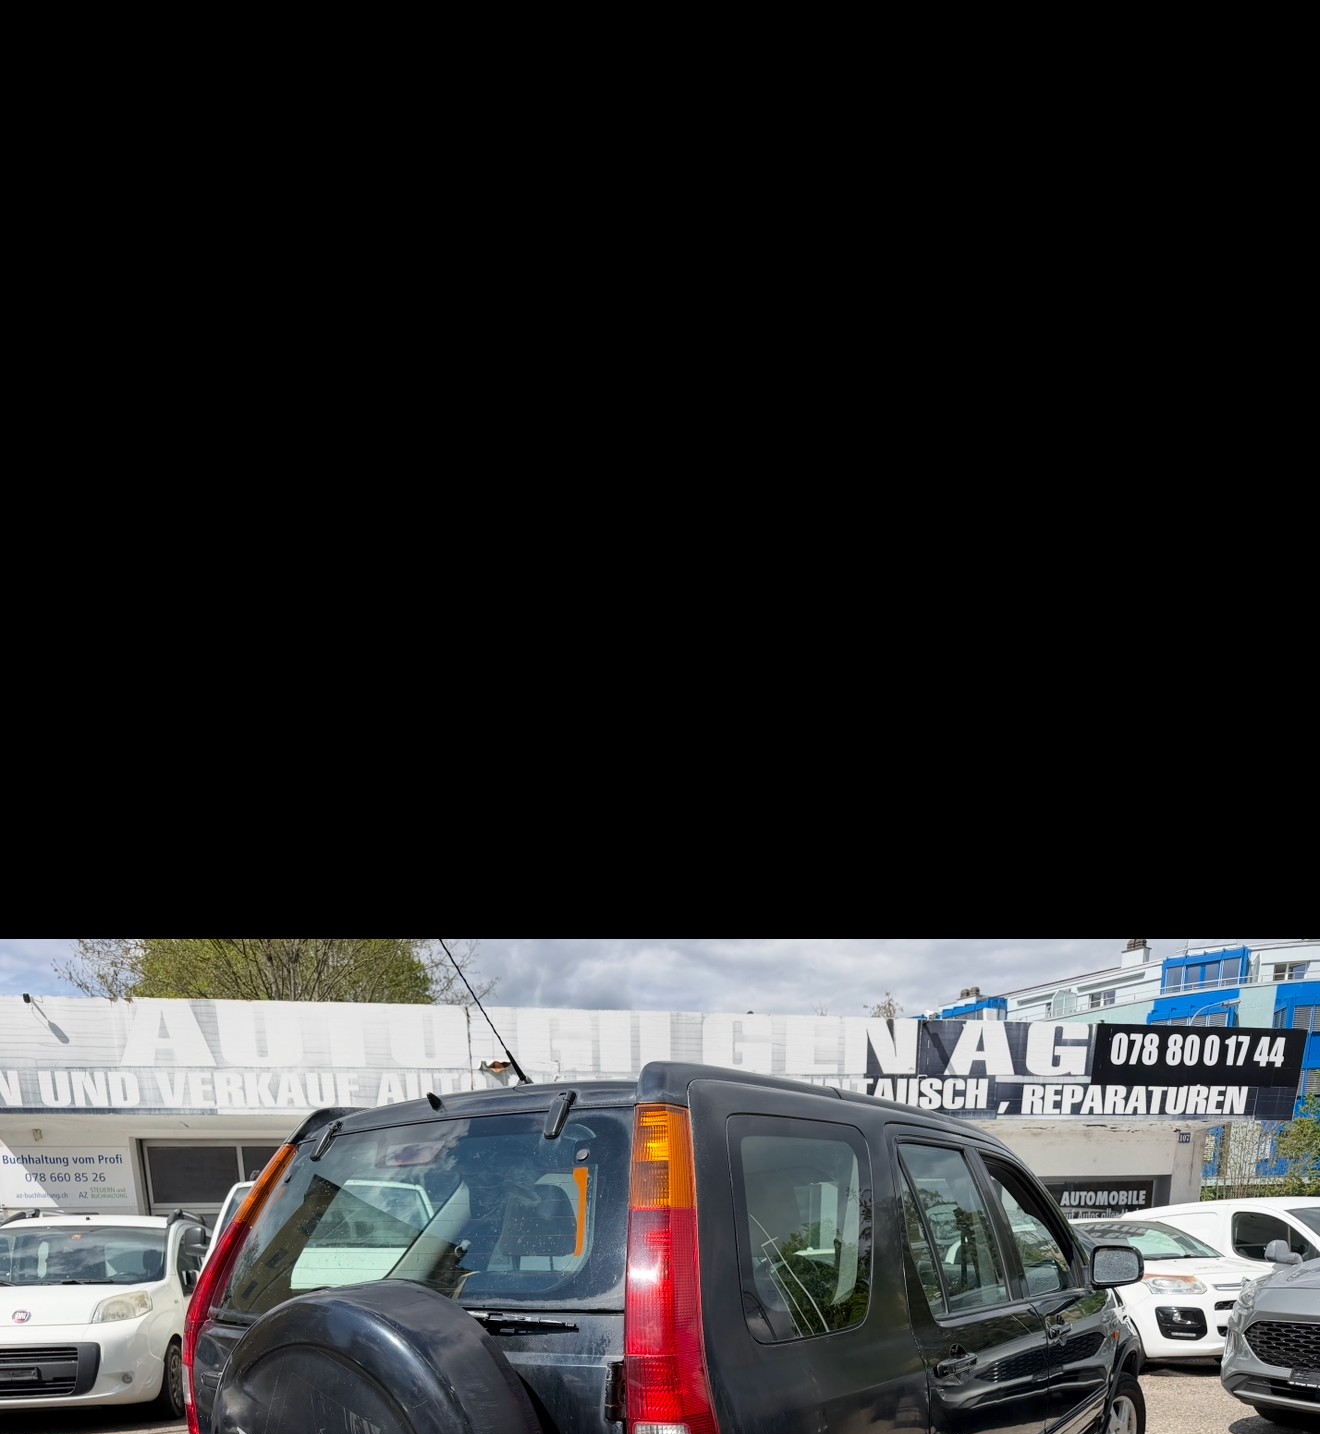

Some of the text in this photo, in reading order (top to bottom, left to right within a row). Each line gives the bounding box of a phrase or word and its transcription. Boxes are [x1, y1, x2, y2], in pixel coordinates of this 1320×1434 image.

[120, 1000, 470, 1068] AUTO
[943, 1020, 1090, 1077] AG
[1110, 1032, 1158, 1066] 078
[1224, 1035, 1250, 1067] 17
[1253, 1037, 1287, 1067] 44
[37, 1071, 141, 1108] UND
[154, 1072, 359, 1108] VERKAUF
[796, 1077, 988, 1110] TAUSCH
[1020, 1084, 1249, 1115] REPARATUREN
[1179, 1134, 1190, 1142] 107
[2, 1154, 123, 1167] Buchhaltung vom Profi
[25, 1172, 106, 1183] 078 660 85 26
[16, 1191, 69, 1200] az-buchhaltung.ch
[78, 1191, 88, 1199] AZ
[1060, 1190, 1147, 1206] AUTOMOBILE
